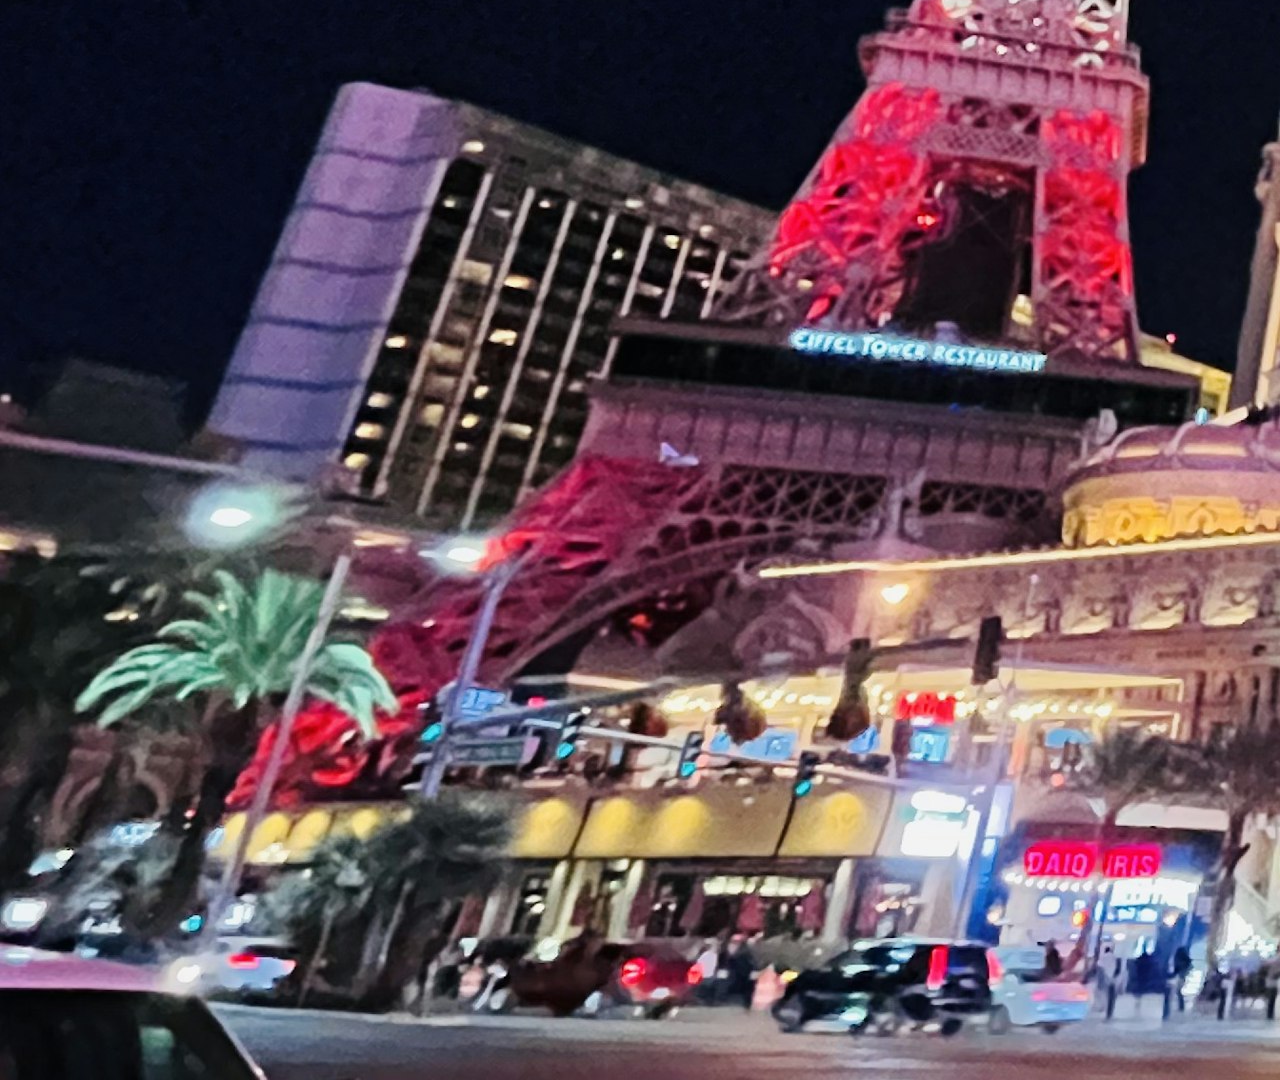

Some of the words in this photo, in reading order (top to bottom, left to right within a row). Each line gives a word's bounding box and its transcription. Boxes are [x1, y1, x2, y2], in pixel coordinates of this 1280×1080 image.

[790, 328, 857, 355] EIFFEL
[860, 333, 926, 361] TOWER
[932, 344, 1047, 372] RESTAURANT
[1026, 850, 1156, 878] DAIQIRIS
